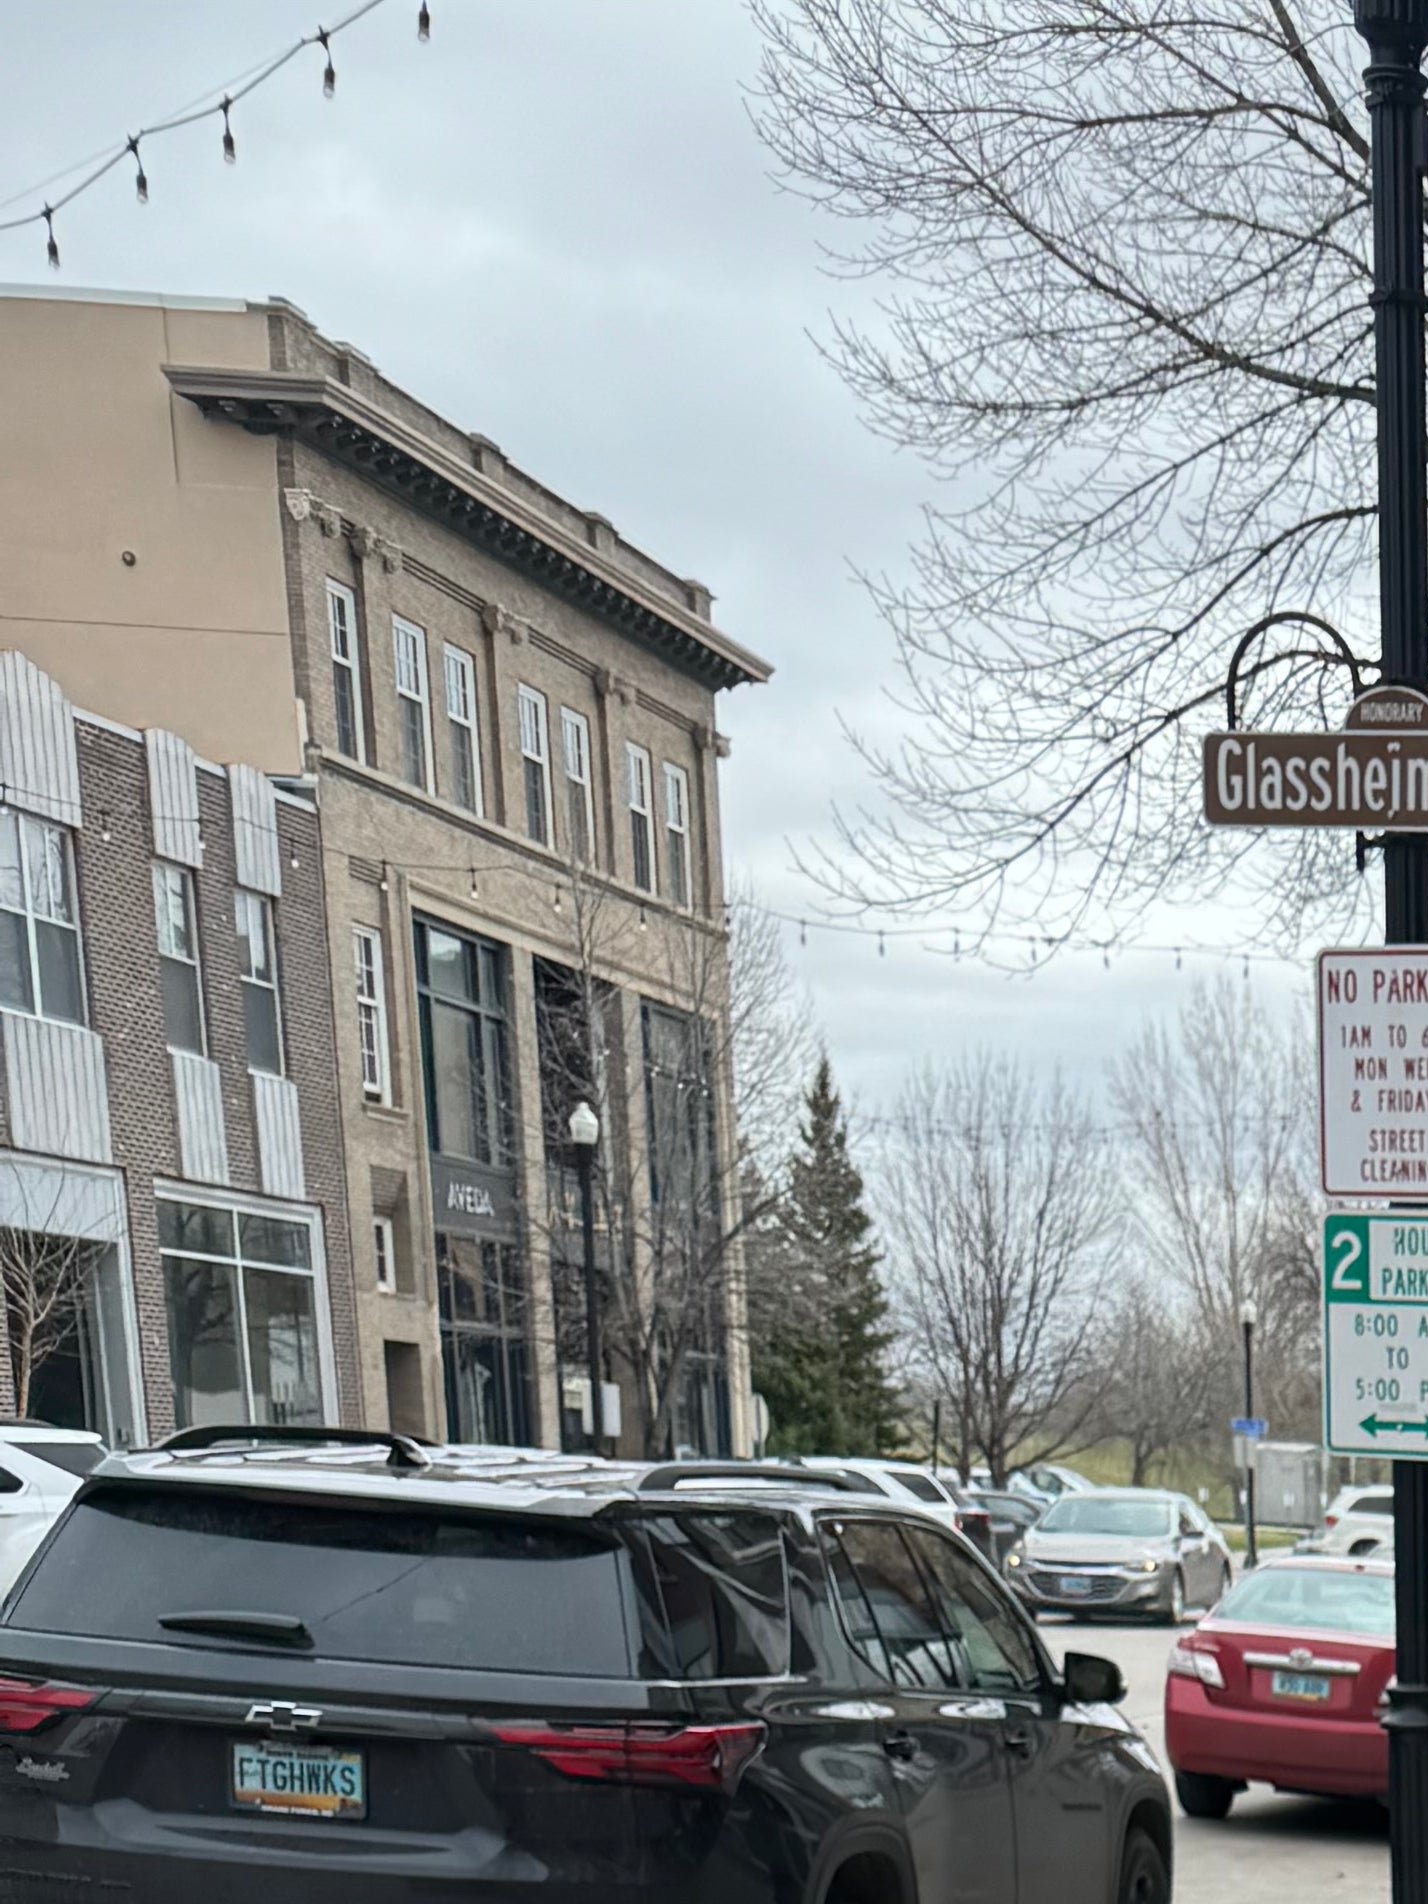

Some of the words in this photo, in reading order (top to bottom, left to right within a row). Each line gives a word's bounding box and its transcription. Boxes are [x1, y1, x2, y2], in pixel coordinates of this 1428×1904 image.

[1360, 702, 1423, 723] HONORARY
[1327, 970, 1358, 1004] NO
[1341, 1025, 1372, 1049] 1AM
[1388, 1025, 1407, 1049] TO
[1354, 1057, 1388, 1081] MON
[1351, 1090, 1362, 1113] &
[1368, 1130, 1426, 1153] STREET
[1331, 1230, 1363, 1290] 2
[1354, 1313, 1398, 1337] 8:00
[1386, 1347, 1410, 1370] TO
[1355, 1378, 1400, 1401] 5:00
[238, 1756, 356, 1797] FTGHWKS
